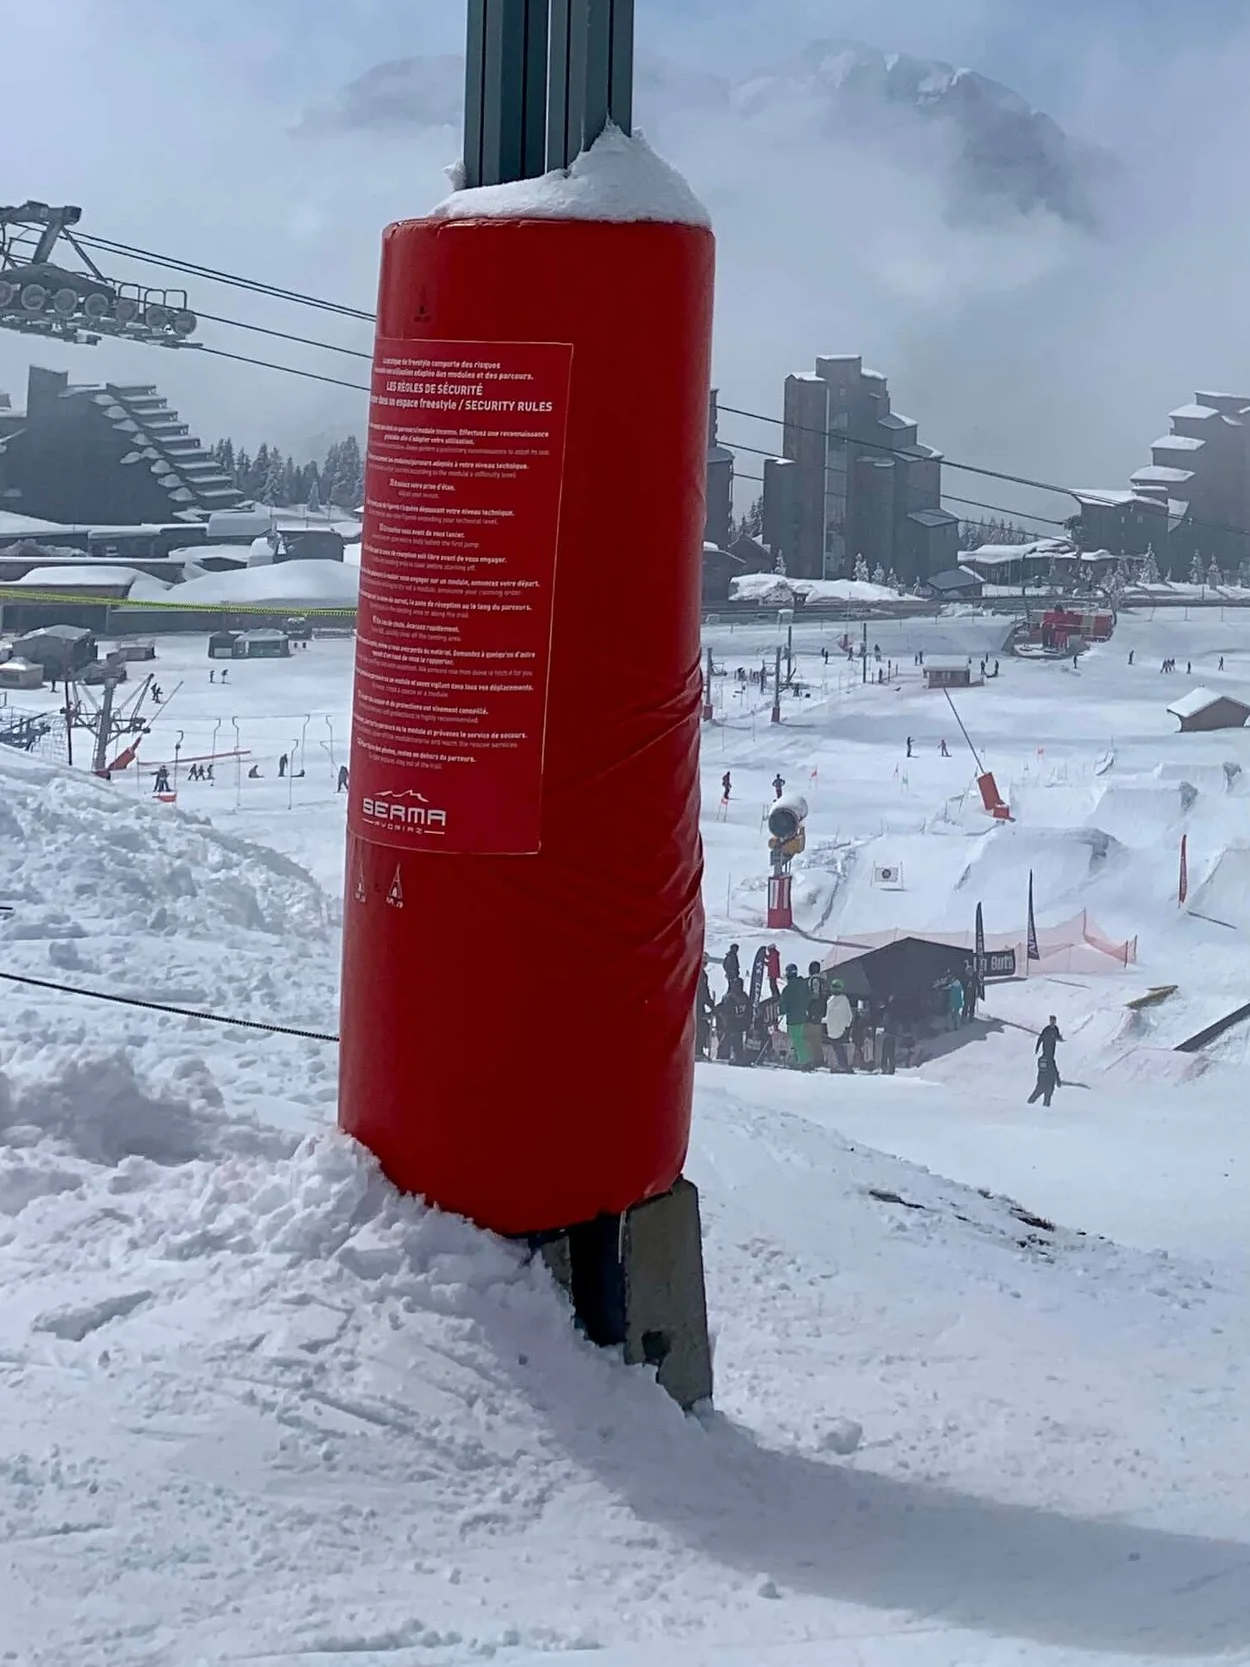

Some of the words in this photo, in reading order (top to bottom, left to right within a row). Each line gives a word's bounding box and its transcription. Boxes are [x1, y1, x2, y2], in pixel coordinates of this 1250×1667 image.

[474, 362, 500, 370] risques
[499, 372, 533, 381] parcours.
[387, 382, 396, 391] LES
[398, 380, 423, 394] RÈGLES
[425, 384, 436, 394] DE
[437, 382, 482, 396] SÉCURITÉ
[396, 399, 417, 409] espace
[420, 397, 457, 411] freestyle
[465, 400, 515, 411] SECURITY
[517, 401, 552, 412] RULES
[459, 429, 486, 437] Effectuez
[500, 430, 549, 438] reconnaissance
[517, 580, 540, 588] départ.
[362, 798, 447, 826] SERMA
